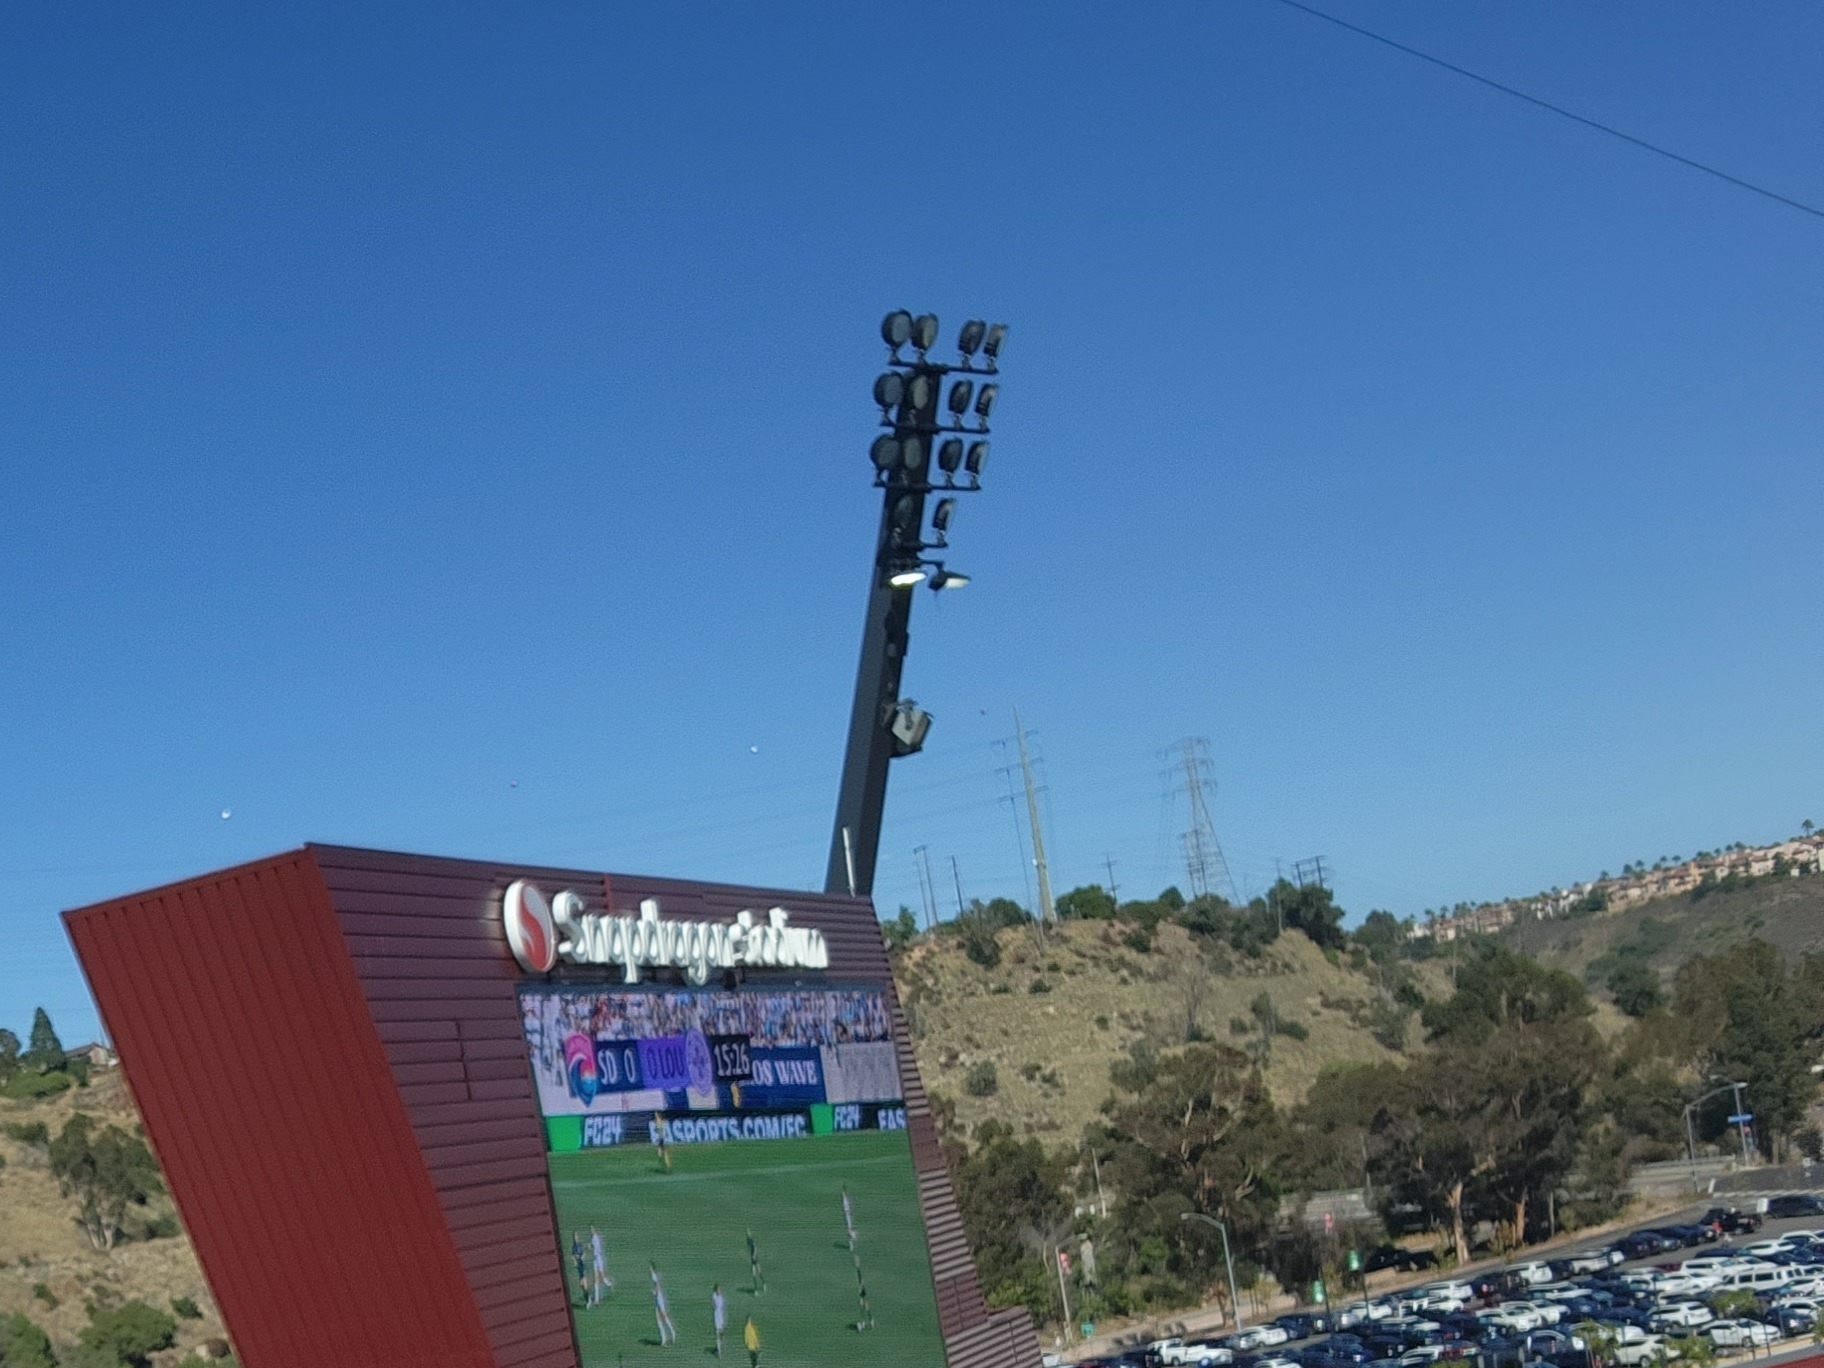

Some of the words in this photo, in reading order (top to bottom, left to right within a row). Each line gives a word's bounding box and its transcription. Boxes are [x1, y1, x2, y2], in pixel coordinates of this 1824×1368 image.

[714, 1042, 750, 1077] 15:26
[776, 1059, 818, 1086] WAVE
[584, 1115, 622, 1146] FC24
